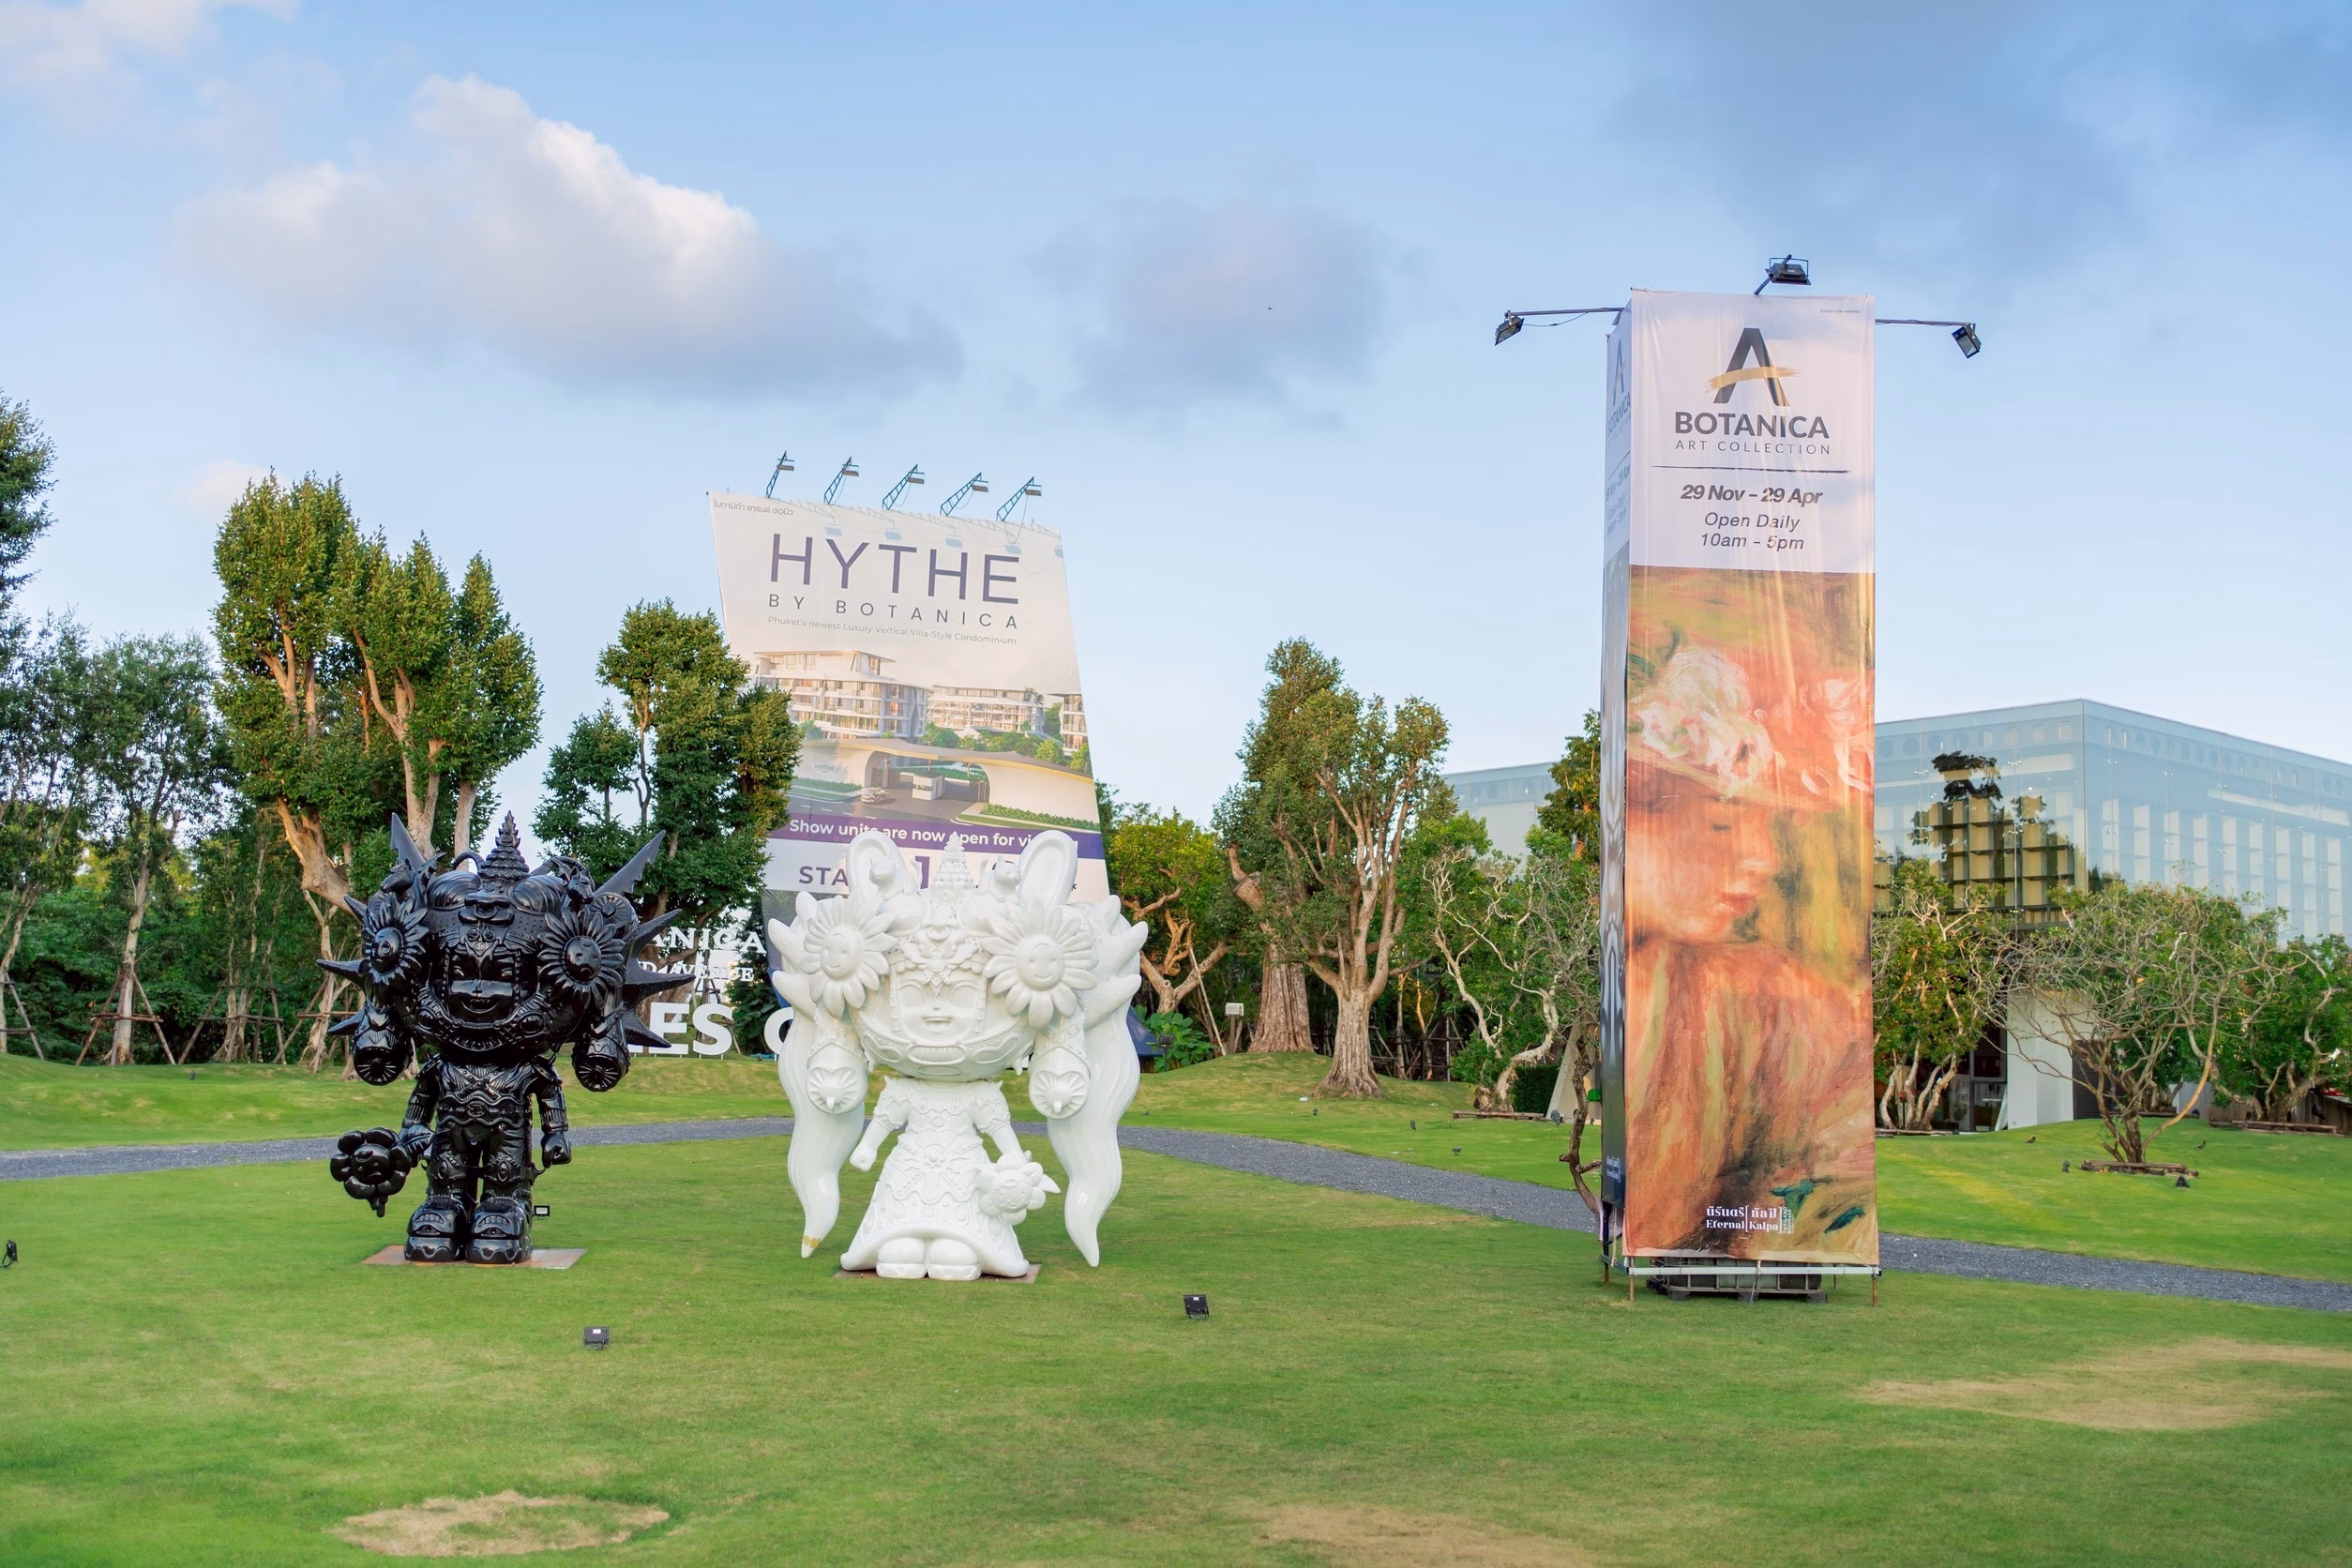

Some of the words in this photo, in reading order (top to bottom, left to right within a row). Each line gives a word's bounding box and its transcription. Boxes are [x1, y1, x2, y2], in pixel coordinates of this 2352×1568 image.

[1675, 411, 1831, 439] BOTANICA
[1675, 439, 1708, 451] ART
[1717, 441, 1832, 456] COLLECTION
[1680, 484, 1705, 500] 29
[1708, 485, 1745, 502] Nov
[1761, 487, 1786, 504] 29
[1787, 488, 1823, 508] Apr
[1704, 512, 1751, 529] Open
[1756, 513, 1802, 533] Daily
[1700, 533, 1747, 548] 10am
[1767, 535, 1805, 551] 5pm
[770, 533, 1020, 605] HYTHE
[768, 594, 805, 610] BY
[836, 599, 1018, 629] BOTANICA
[768, 615, 807, 627] Phuket's
[808, 620, 841, 630] newest
[843, 623, 873, 634] Luxury
[875, 625, 909, 636] Vertical
[910, 627, 953, 641] Villa-Style
[954, 632, 1017, 645] Condominium
[790, 819, 835, 836] Show
[882, 827, 908, 840] are
[912, 830, 945, 842] now
[959, 833, 989, 847] pen
[992, 832, 1015, 846] for
[798, 865, 849, 886] STA
[1706, 1219, 1745, 1229] Eternal
